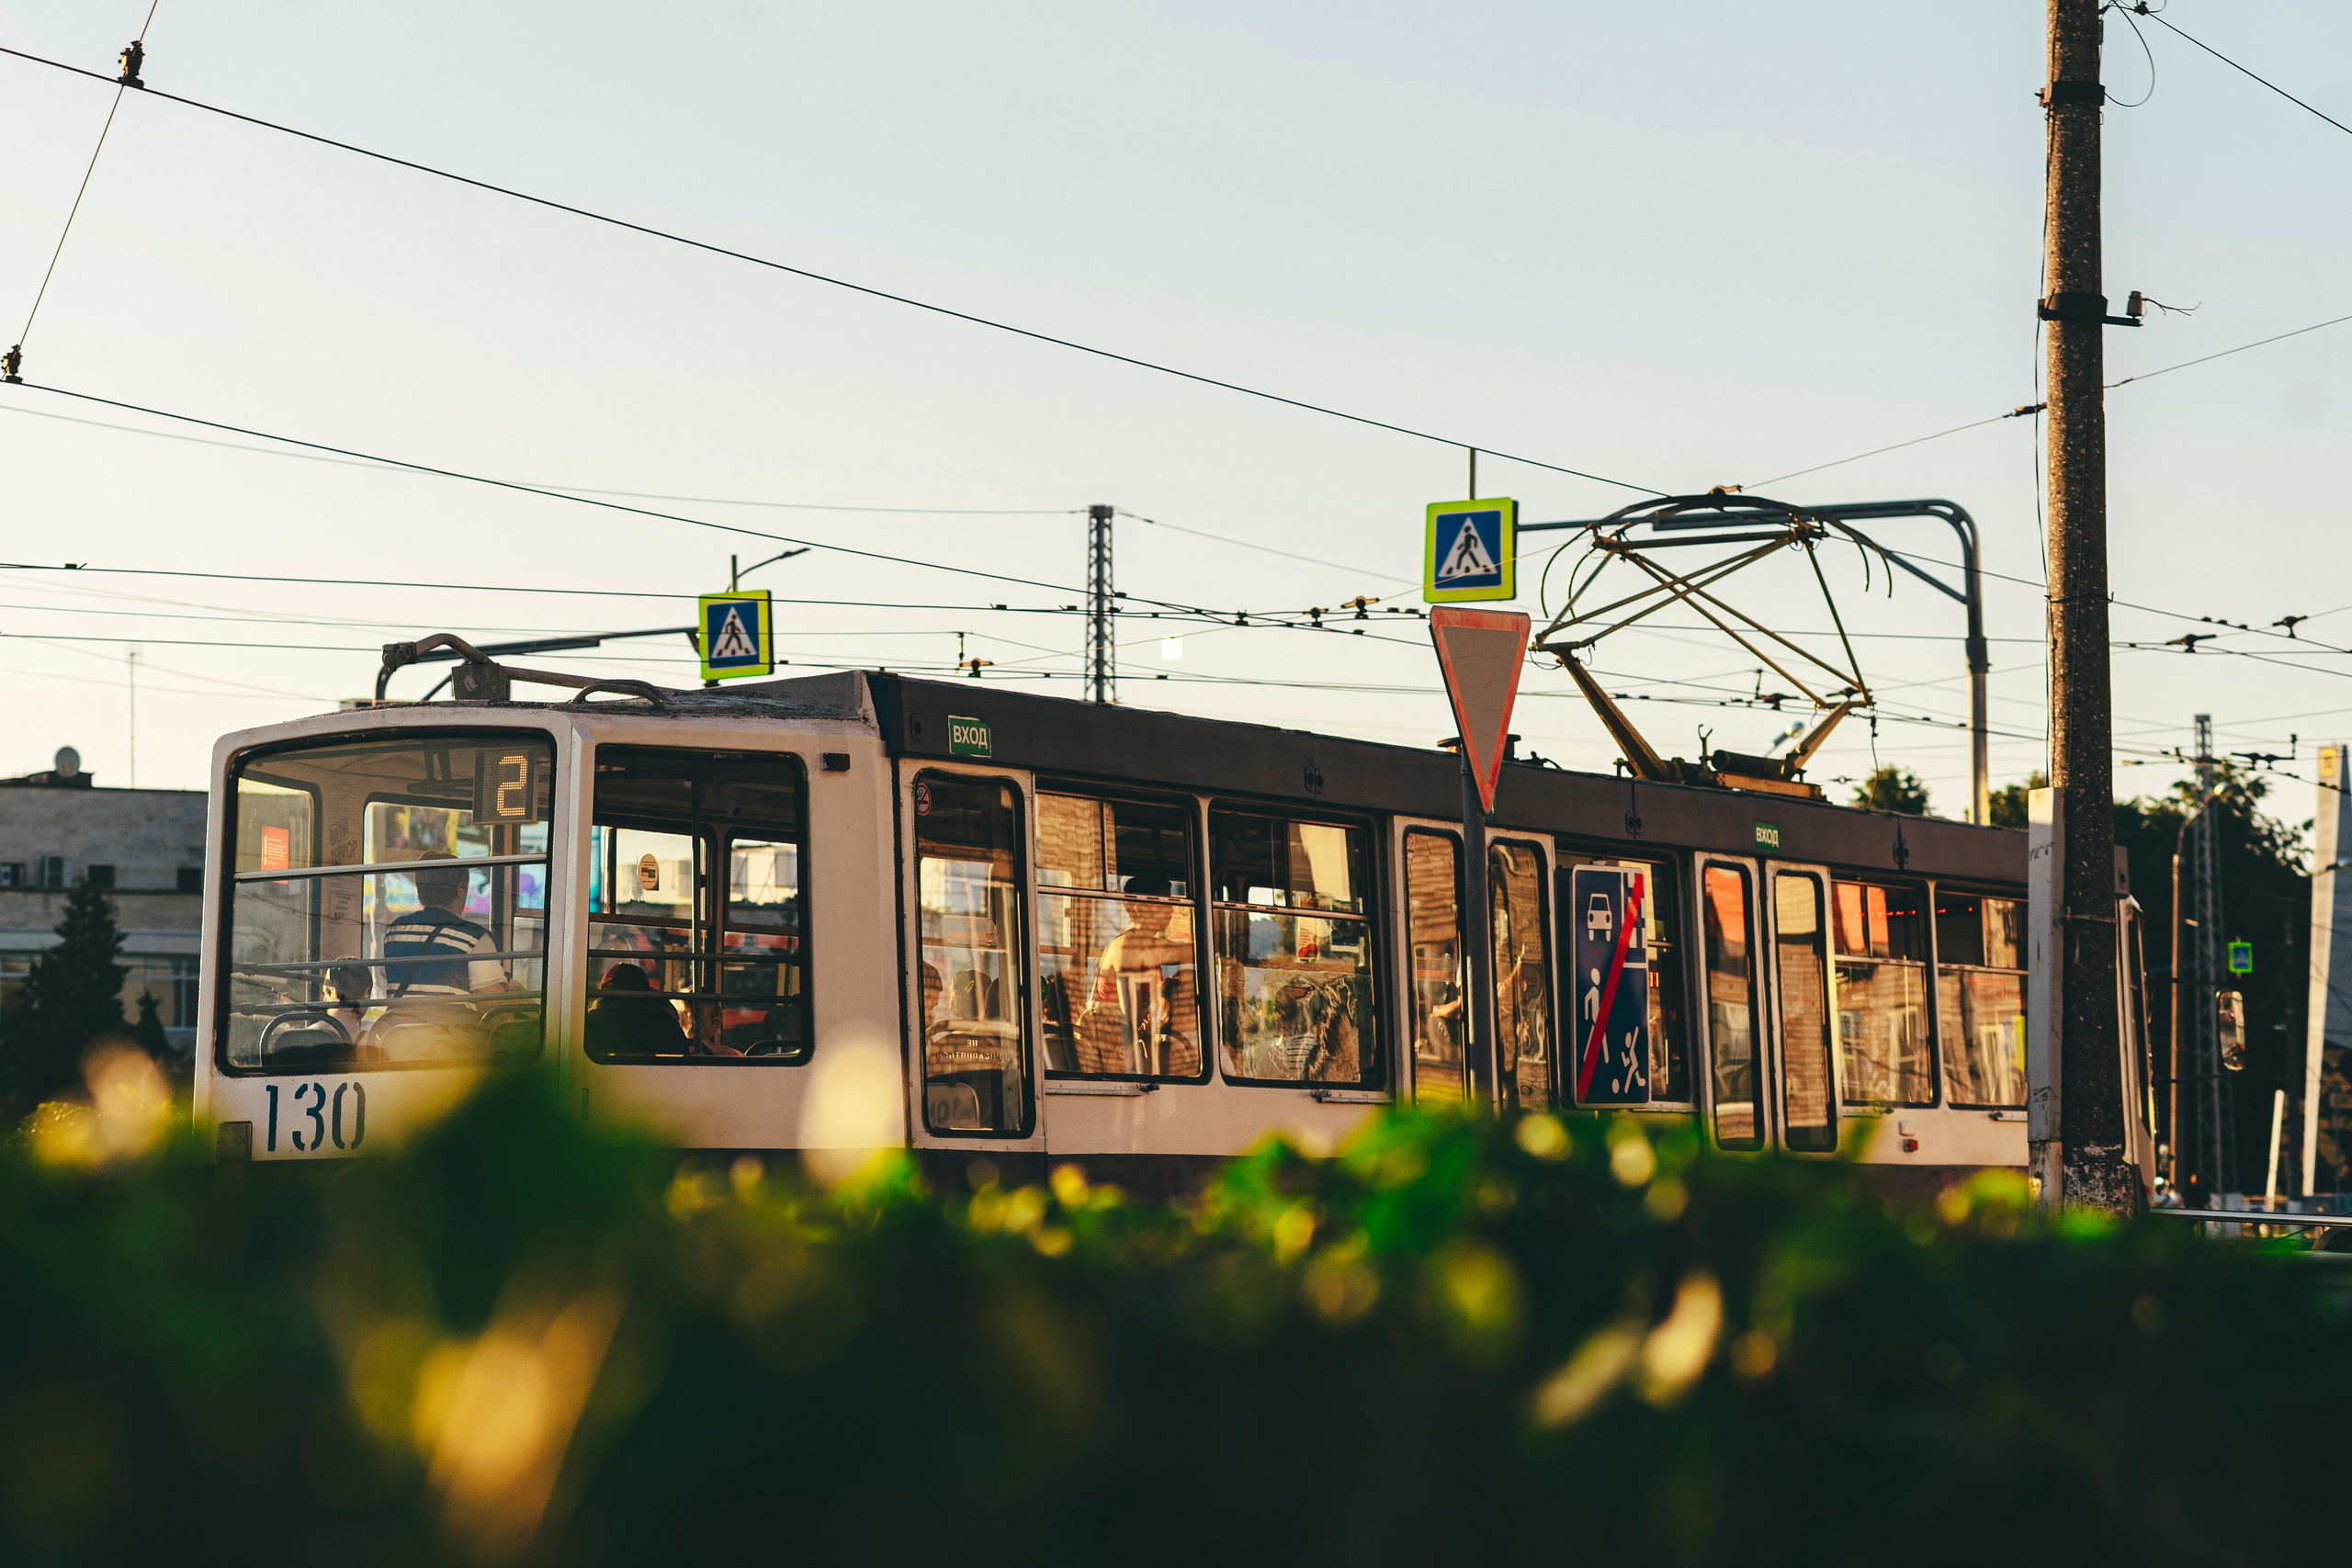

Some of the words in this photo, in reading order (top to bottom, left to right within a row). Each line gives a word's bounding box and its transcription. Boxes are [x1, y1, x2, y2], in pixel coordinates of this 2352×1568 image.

[953, 725, 989, 750] ВХОД
[497, 755, 528, 817] 2
[1756, 827, 1780, 848] ВХОД
[266, 1081, 366, 1152] 130
